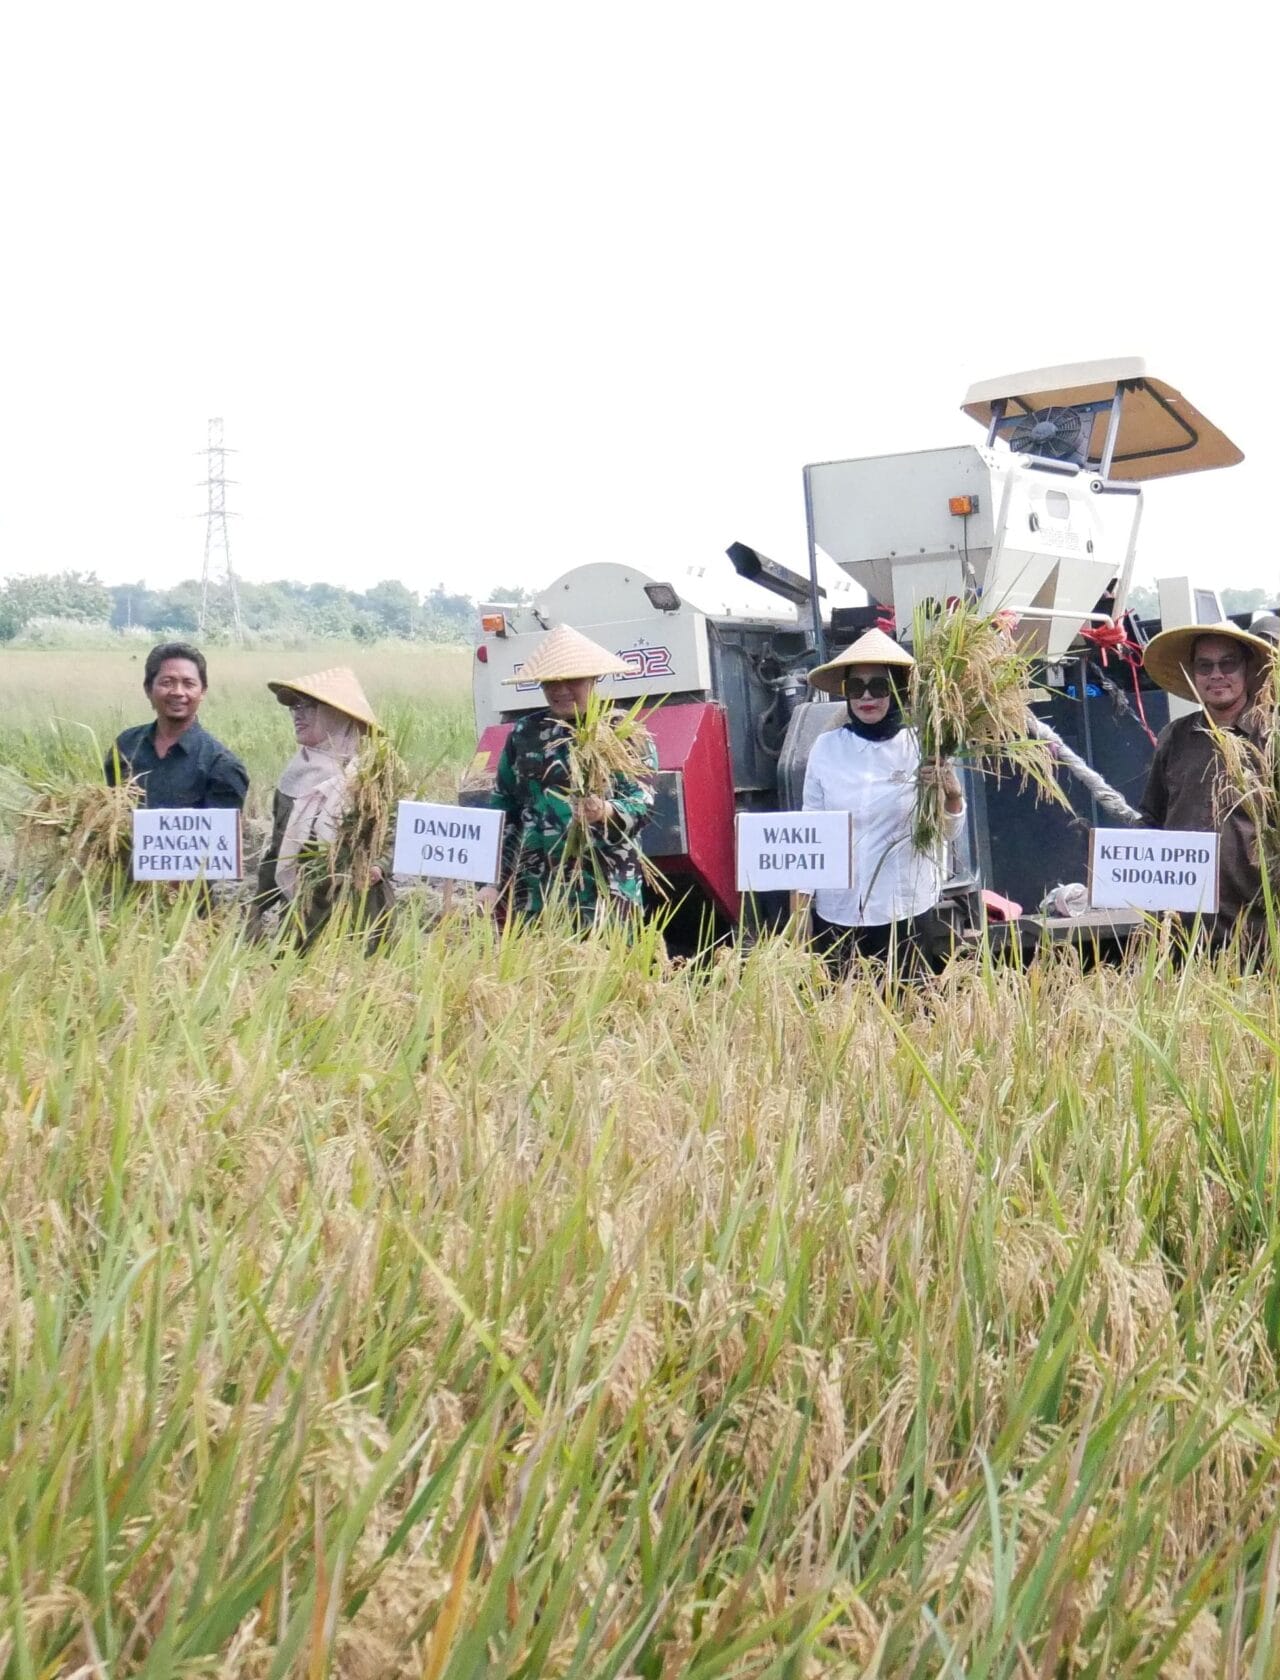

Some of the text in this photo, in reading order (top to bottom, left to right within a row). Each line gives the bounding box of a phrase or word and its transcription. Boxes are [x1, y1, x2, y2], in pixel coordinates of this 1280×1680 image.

[159, 815, 212, 831] KADIN
[414, 818, 481, 841] DANDIM
[143, 835, 229, 851] PANGAN &
[763, 827, 822, 844] WAKIL
[421, 844, 469, 864] 0816
[759, 853, 825, 870] BUPATI
[1100, 845, 1210, 864] KETUA DPRD
[139, 855, 233, 871] PERTANIAN
[1111, 868, 1197, 886] SIDOARJO
